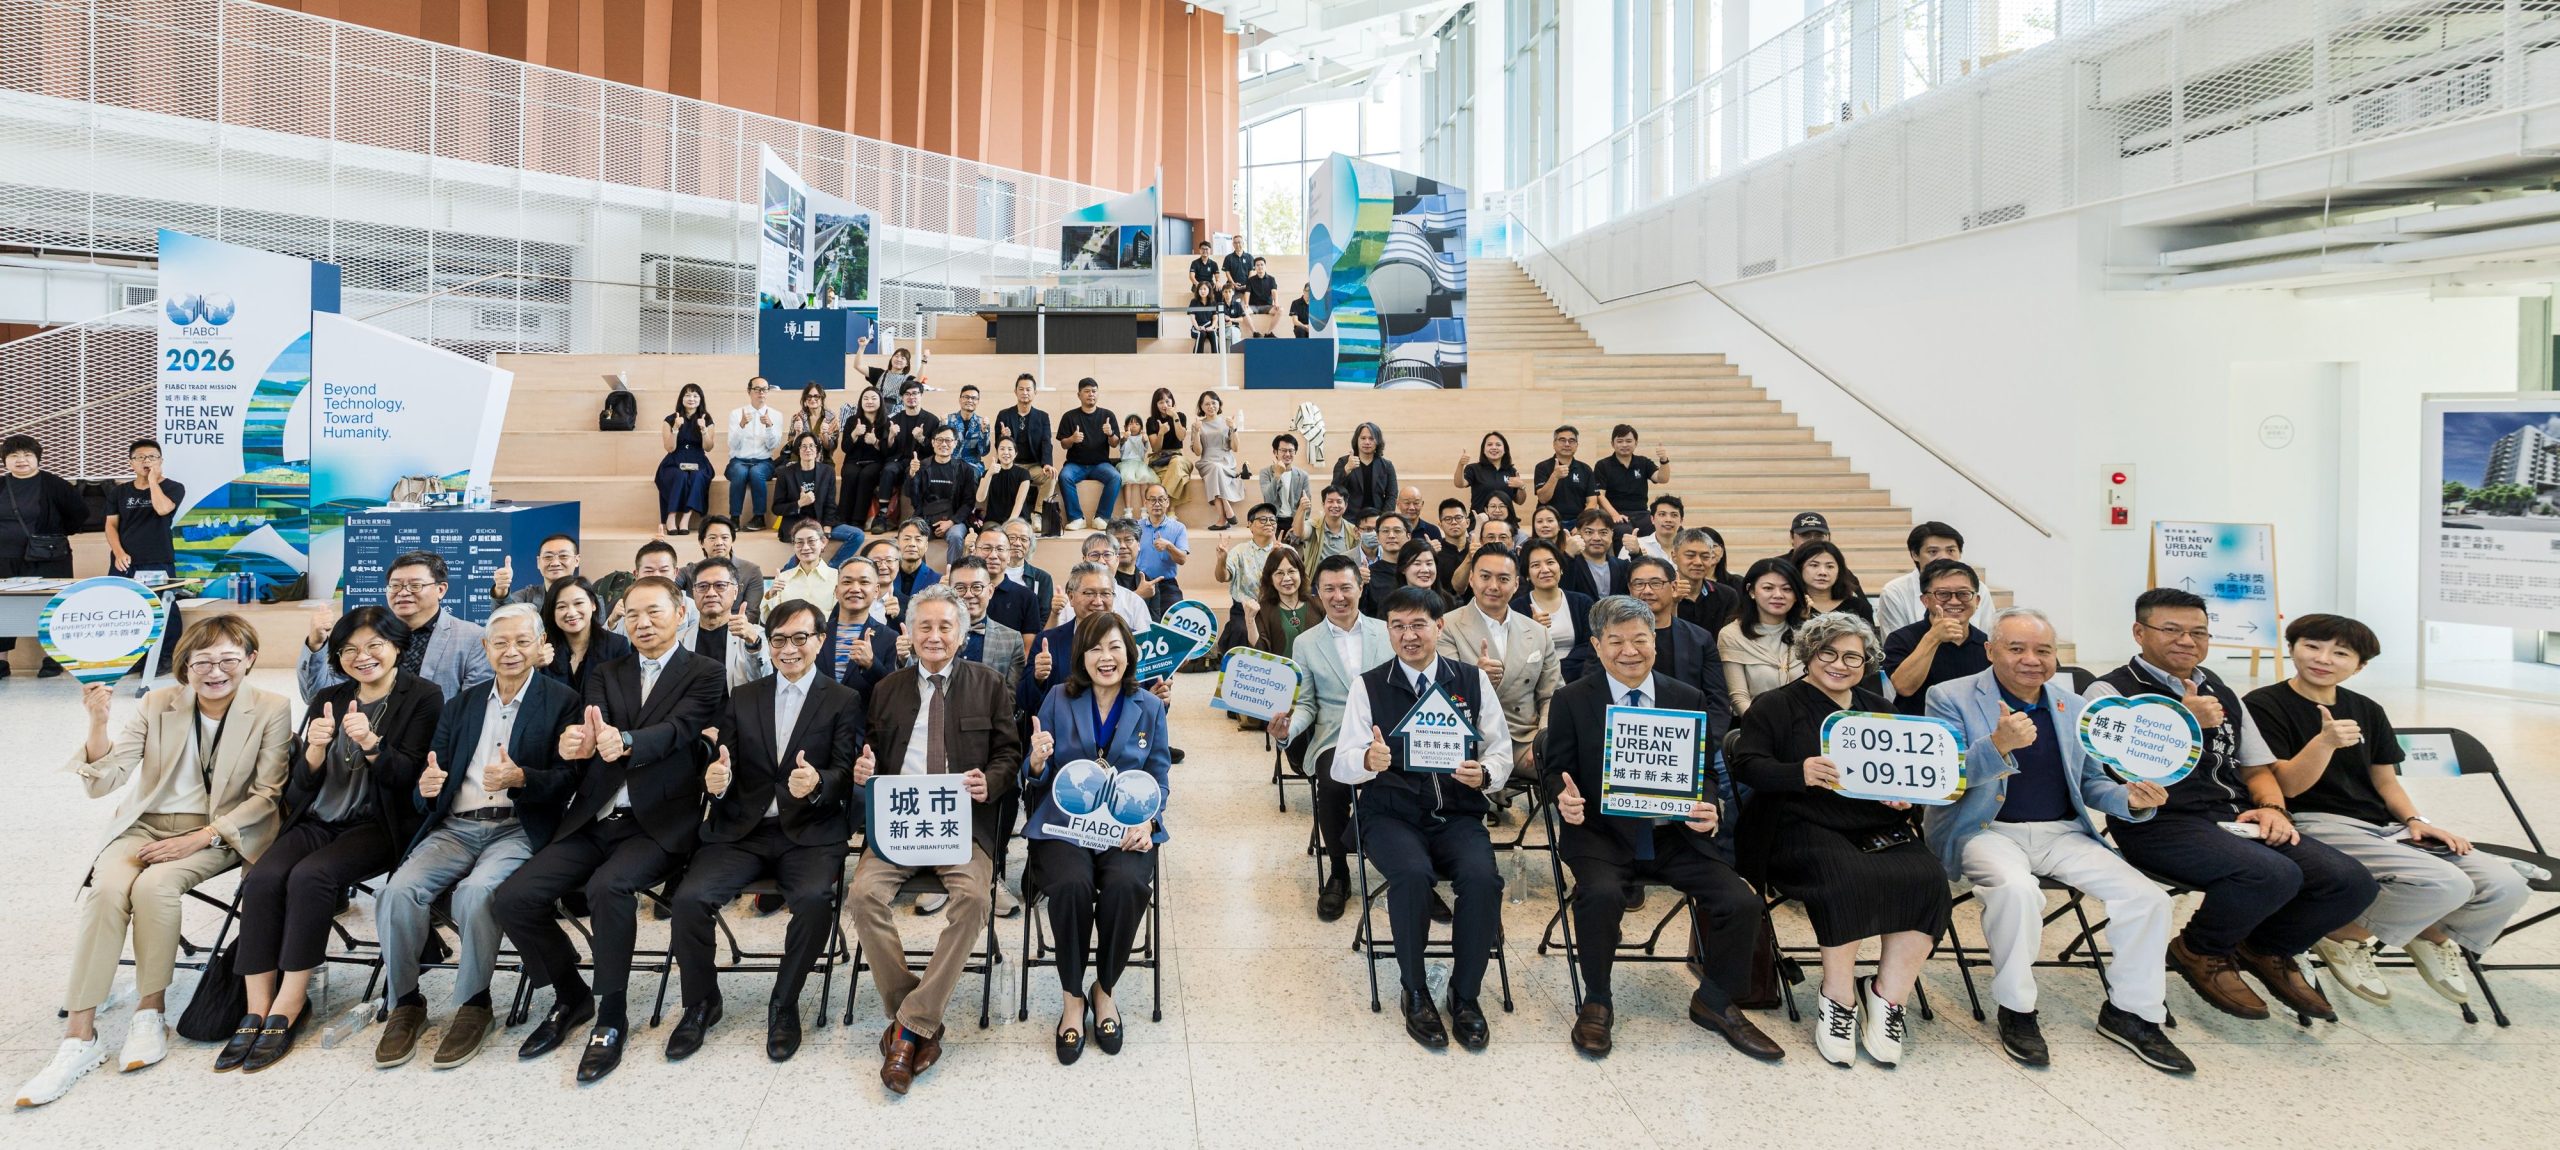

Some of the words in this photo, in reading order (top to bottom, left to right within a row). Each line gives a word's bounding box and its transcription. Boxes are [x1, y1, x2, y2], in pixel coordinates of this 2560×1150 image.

[182, 327, 219, 336] FIABCI
[166, 348, 235, 372] 2026
[323, 382, 377, 397] Beyond
[165, 406, 198, 417] THE
[200, 406, 234, 417] NEW
[323, 397, 405, 413] Technology,
[165, 419, 218, 431] URBAN
[323, 411, 374, 425] Toward
[165, 433, 225, 445] FUTURE
[323, 425, 391, 441] Humanity.
[2165, 535, 2185, 543] THE
[2188, 536, 2213, 544] NEW
[2165, 543, 2203, 551] URBAN
[2165, 550, 2208, 558] FUTURE
[2226, 572, 2265, 583] 全球獎
[2214, 583, 2266, 595] 得獎作品
[62, 611, 104, 623] FENG
[108, 609, 147, 620] CHIA
[52, 623, 96, 632] UNIVERSITY
[1174, 615, 1207, 637] 2026
[1136, 665, 1152, 673] TRADE
[1152, 660, 1173, 670] MISSION
[1237, 659, 1272, 676] Beyond
[1233, 680, 1265, 695] Toward
[1235, 669, 1287, 691] Technology,
[1230, 690, 1275, 710] Humanity
[1415, 711, 1457, 727] 2026
[2094, 715, 2127, 733] 城市
[2135, 714, 2173, 732] Beyond
[1617, 723, 1648, 737] THE
[1653, 726, 1691, 740] NEW
[1842, 726, 1856, 736] 20
[2091, 728, 2125, 744] 新未來
[2133, 725, 2188, 749] Technology,
[1413, 740, 1461, 750] 城市新未來
[1616, 737, 1672, 752] URBAN
[1842, 739, 1857, 749] 26
[1861, 728, 1935, 755] 09.12
[2130, 736, 2165, 753] Toward
[1615, 751, 1679, 767] FUTURE
[2126, 747, 2173, 768] Humanity
[1613, 767, 1690, 784] 城市新未來
[1862, 761, 1937, 789] 09.19
[889, 787, 959, 816] 城市
[1617, 798, 1648, 810] 09.12
[1660, 801, 1691, 813] 09.19
[889, 819, 960, 839] 新未來
[1047, 827, 1084, 838] INTERNATIONAL
[1097, 836, 1115, 844] ESTATE
[1071, 817, 1126, 839] FIABCI
[1082, 840, 1107, 850] TAIWAN
